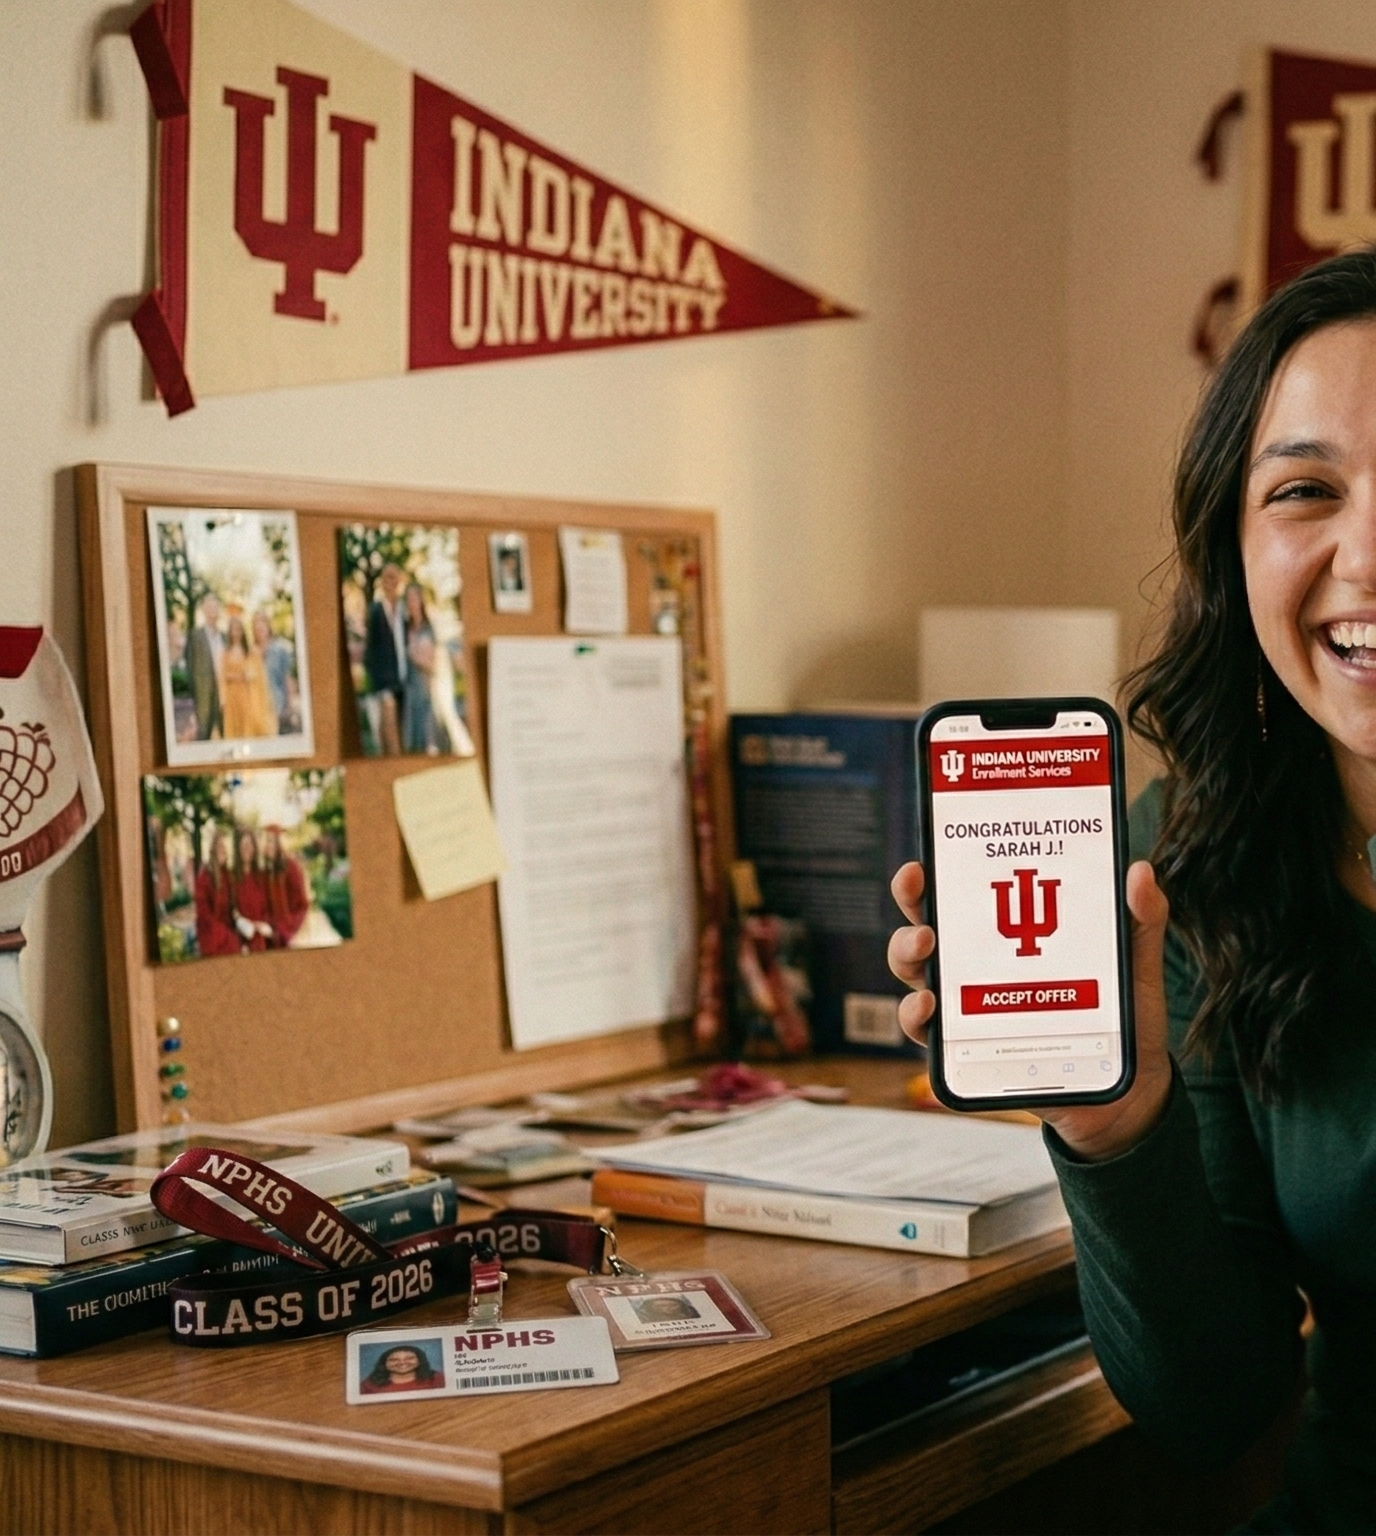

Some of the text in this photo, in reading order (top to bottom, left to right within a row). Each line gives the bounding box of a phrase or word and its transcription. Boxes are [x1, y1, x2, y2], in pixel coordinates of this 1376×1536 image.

[450, 113, 727, 290] INDIANA
[449, 243, 728, 351] UNIVERSITY
[972, 748, 1100, 766] INDIANA UNIVERSITY
[972, 764, 1071, 780] Enrollment Services
[944, 818, 1103, 839] CONGRATULATIONS
[986, 840, 1064, 858] SARAH J.!
[982, 988, 1077, 1006] ACCEPT OFFER
[197, 1154, 293, 1215] NPHS
[174, 1258, 433, 1336] CLASS OF 2026
[66, 1299, 100, 1322] THE
[454, 1329, 556, 1352] NPHS
